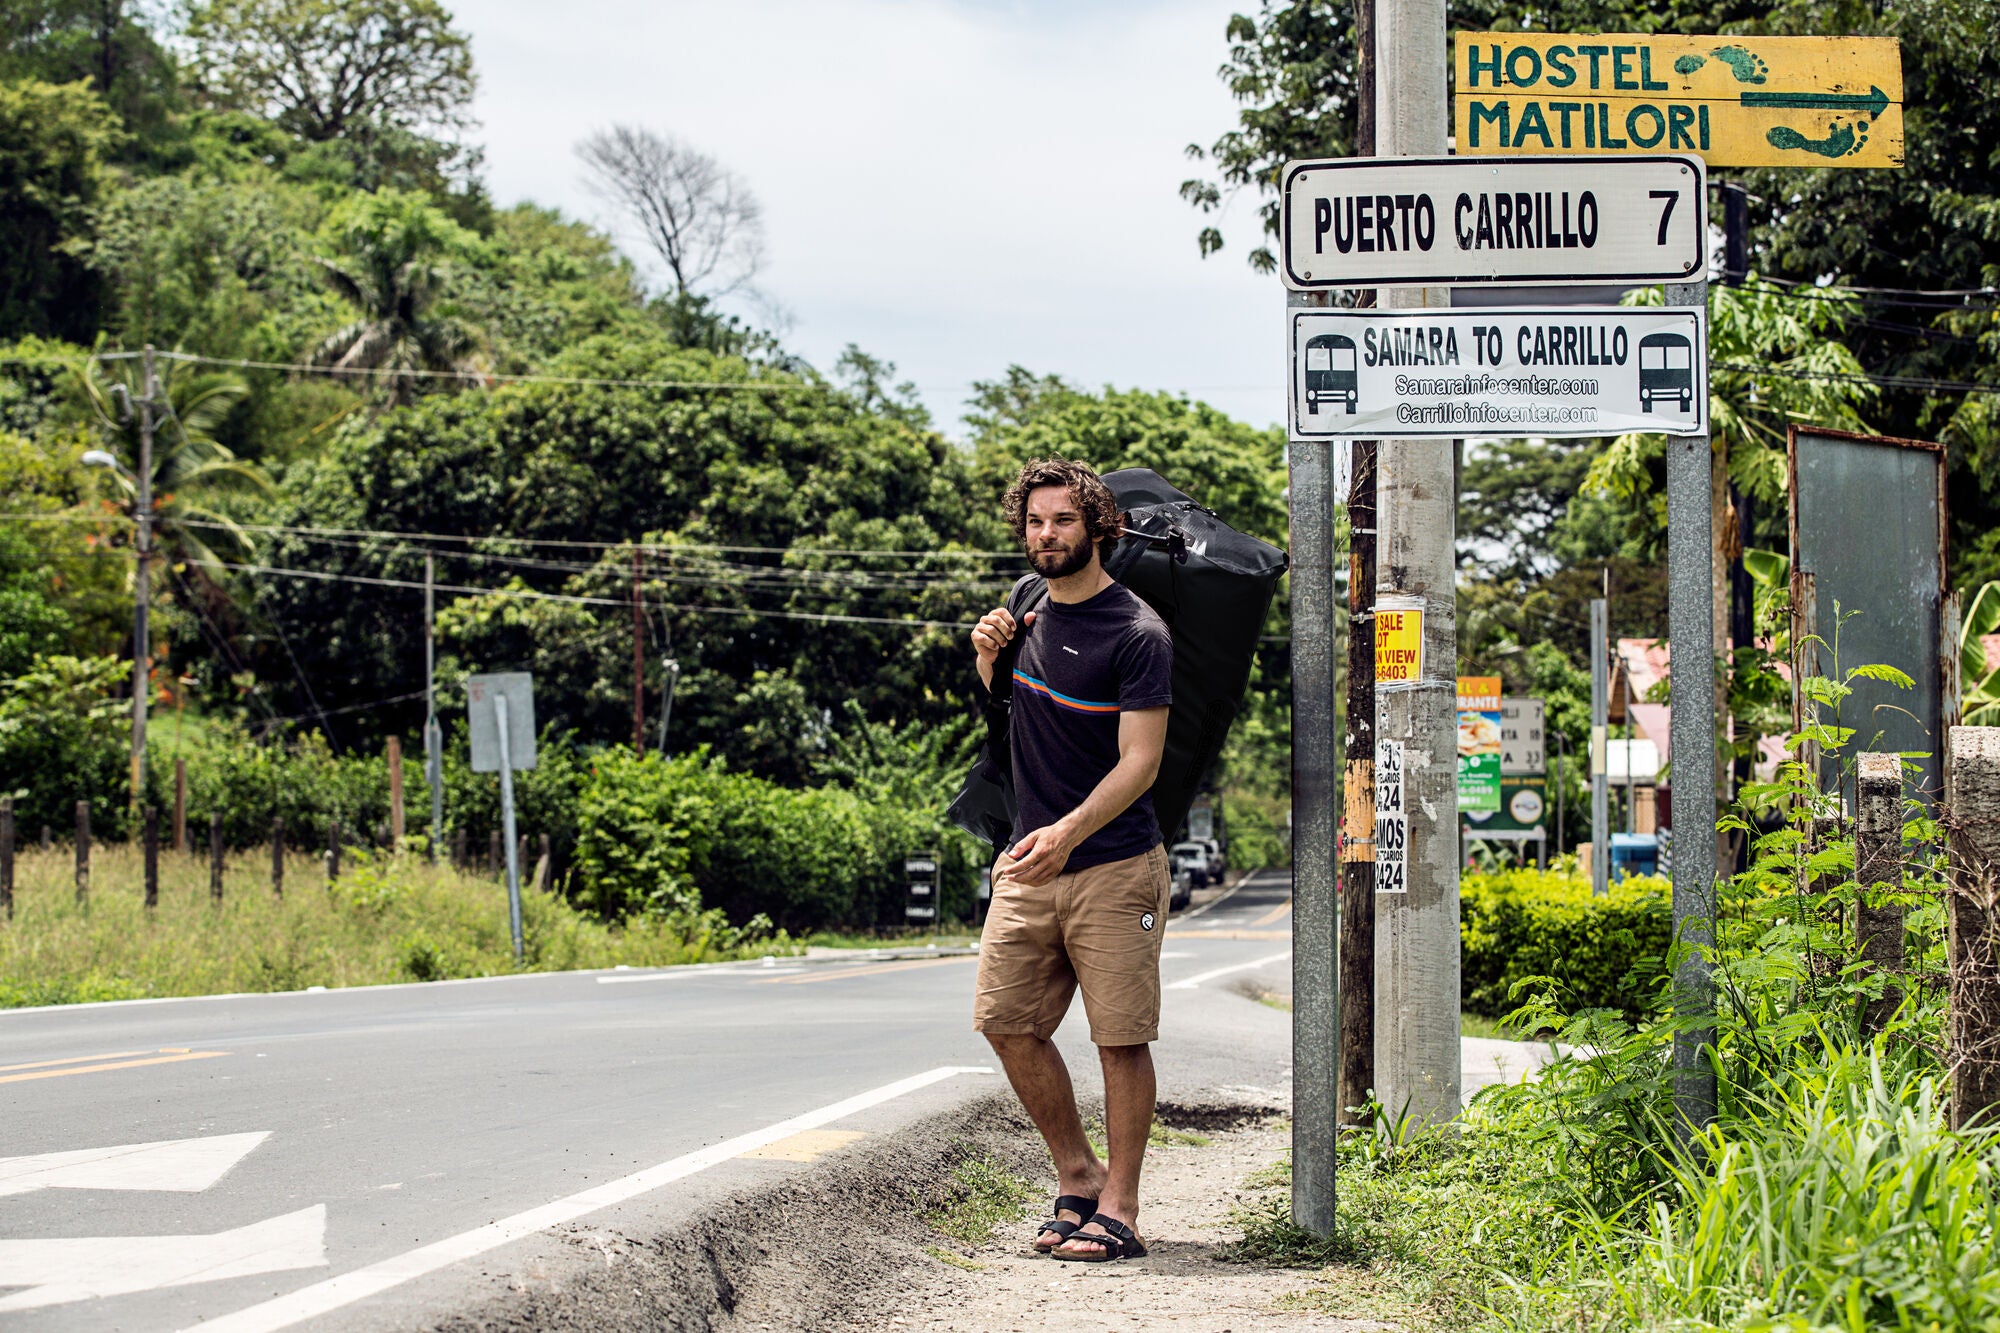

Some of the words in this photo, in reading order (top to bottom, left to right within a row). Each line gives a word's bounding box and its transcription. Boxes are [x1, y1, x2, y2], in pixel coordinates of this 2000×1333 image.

[1468, 45, 1668, 91] HOSTEL
[1468, 101, 1710, 150] MATILORI
[1314, 193, 1435, 254] PUERTO
[1454, 190, 1599, 251] CARRILLO
[1648, 190, 1680, 246] 7
[1363, 326, 1460, 367] SAMARA
[1473, 326, 1503, 366] TO
[1517, 325, 1628, 366] CARRILLO
[1394, 374, 1599, 397] Samarainfocenter.com
[1396, 402, 1599, 425] Carrilloinfocenter.com
[1380, 614, 1403, 631] SALE
[1385, 649, 1416, 664] VIEW
[1457, 696, 1498, 709] RANTE
